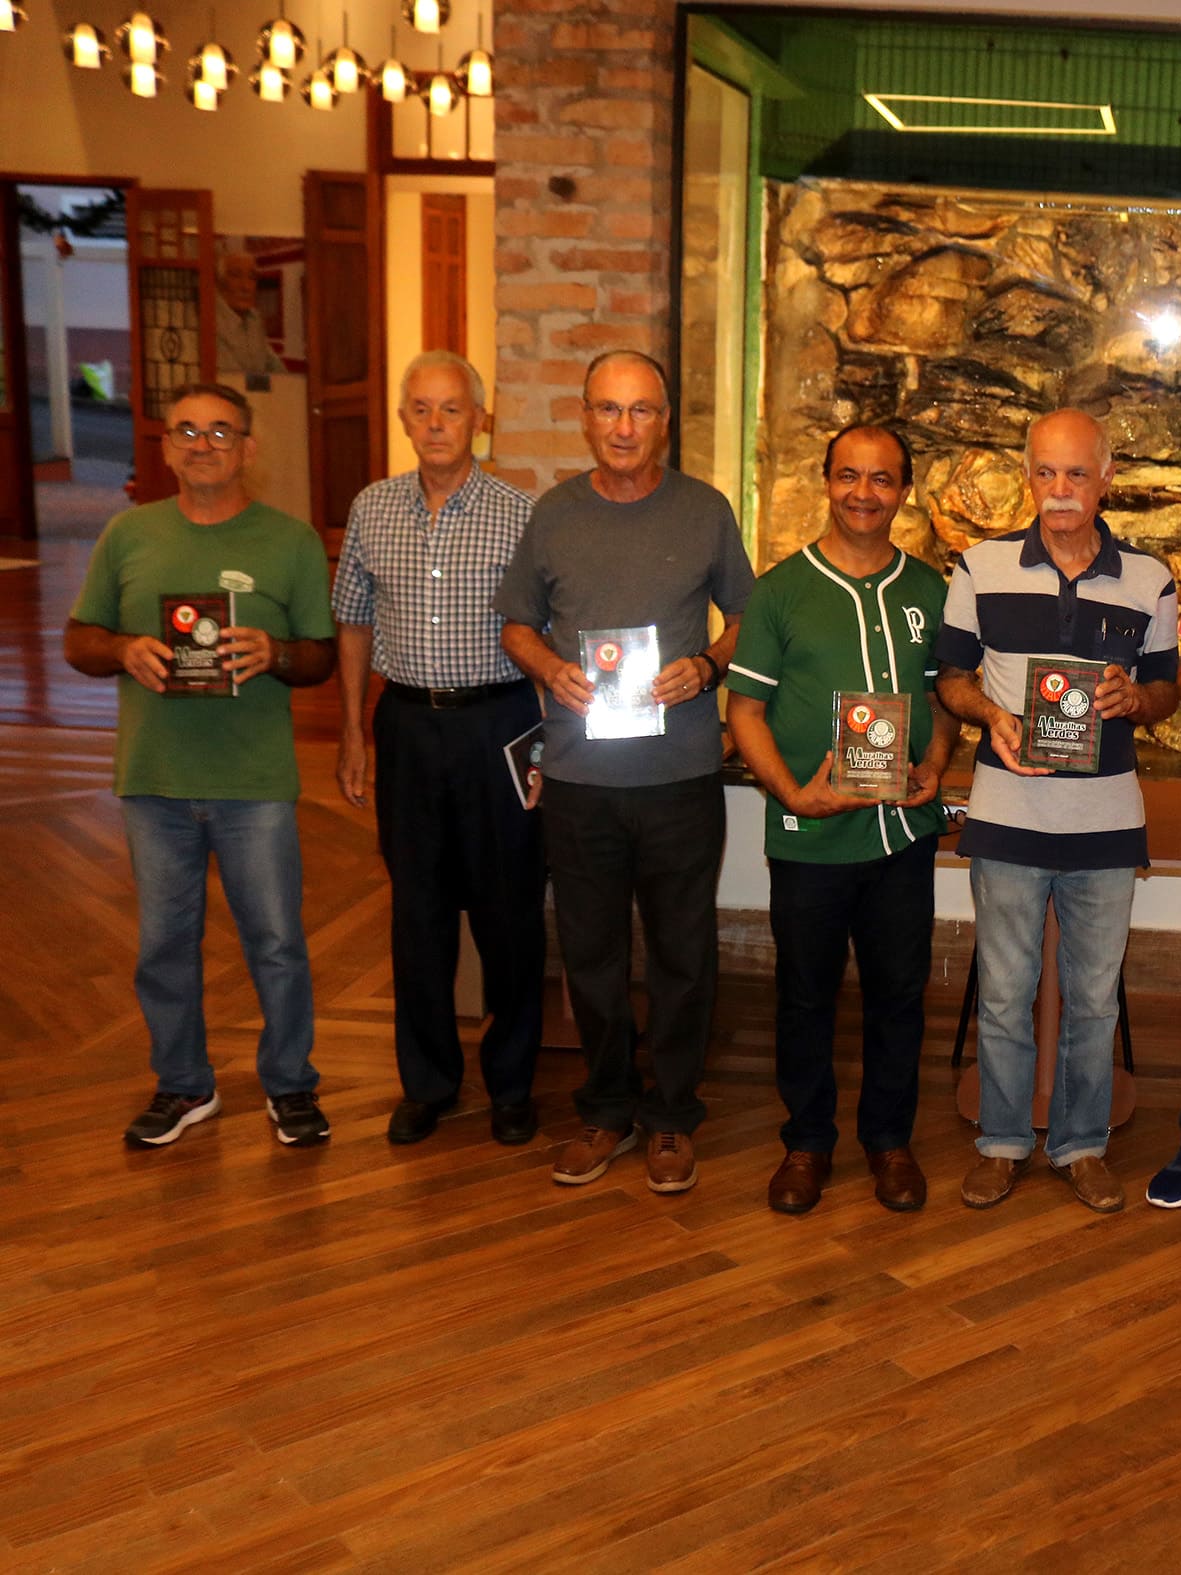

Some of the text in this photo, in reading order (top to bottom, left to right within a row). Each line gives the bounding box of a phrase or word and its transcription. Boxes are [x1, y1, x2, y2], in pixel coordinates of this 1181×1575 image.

[1037, 716, 1086, 732] Muralhas
[1041, 726, 1079, 740] Verdes
[846, 746, 894, 760] Muralhas
[850, 756, 887, 769] Verdes
